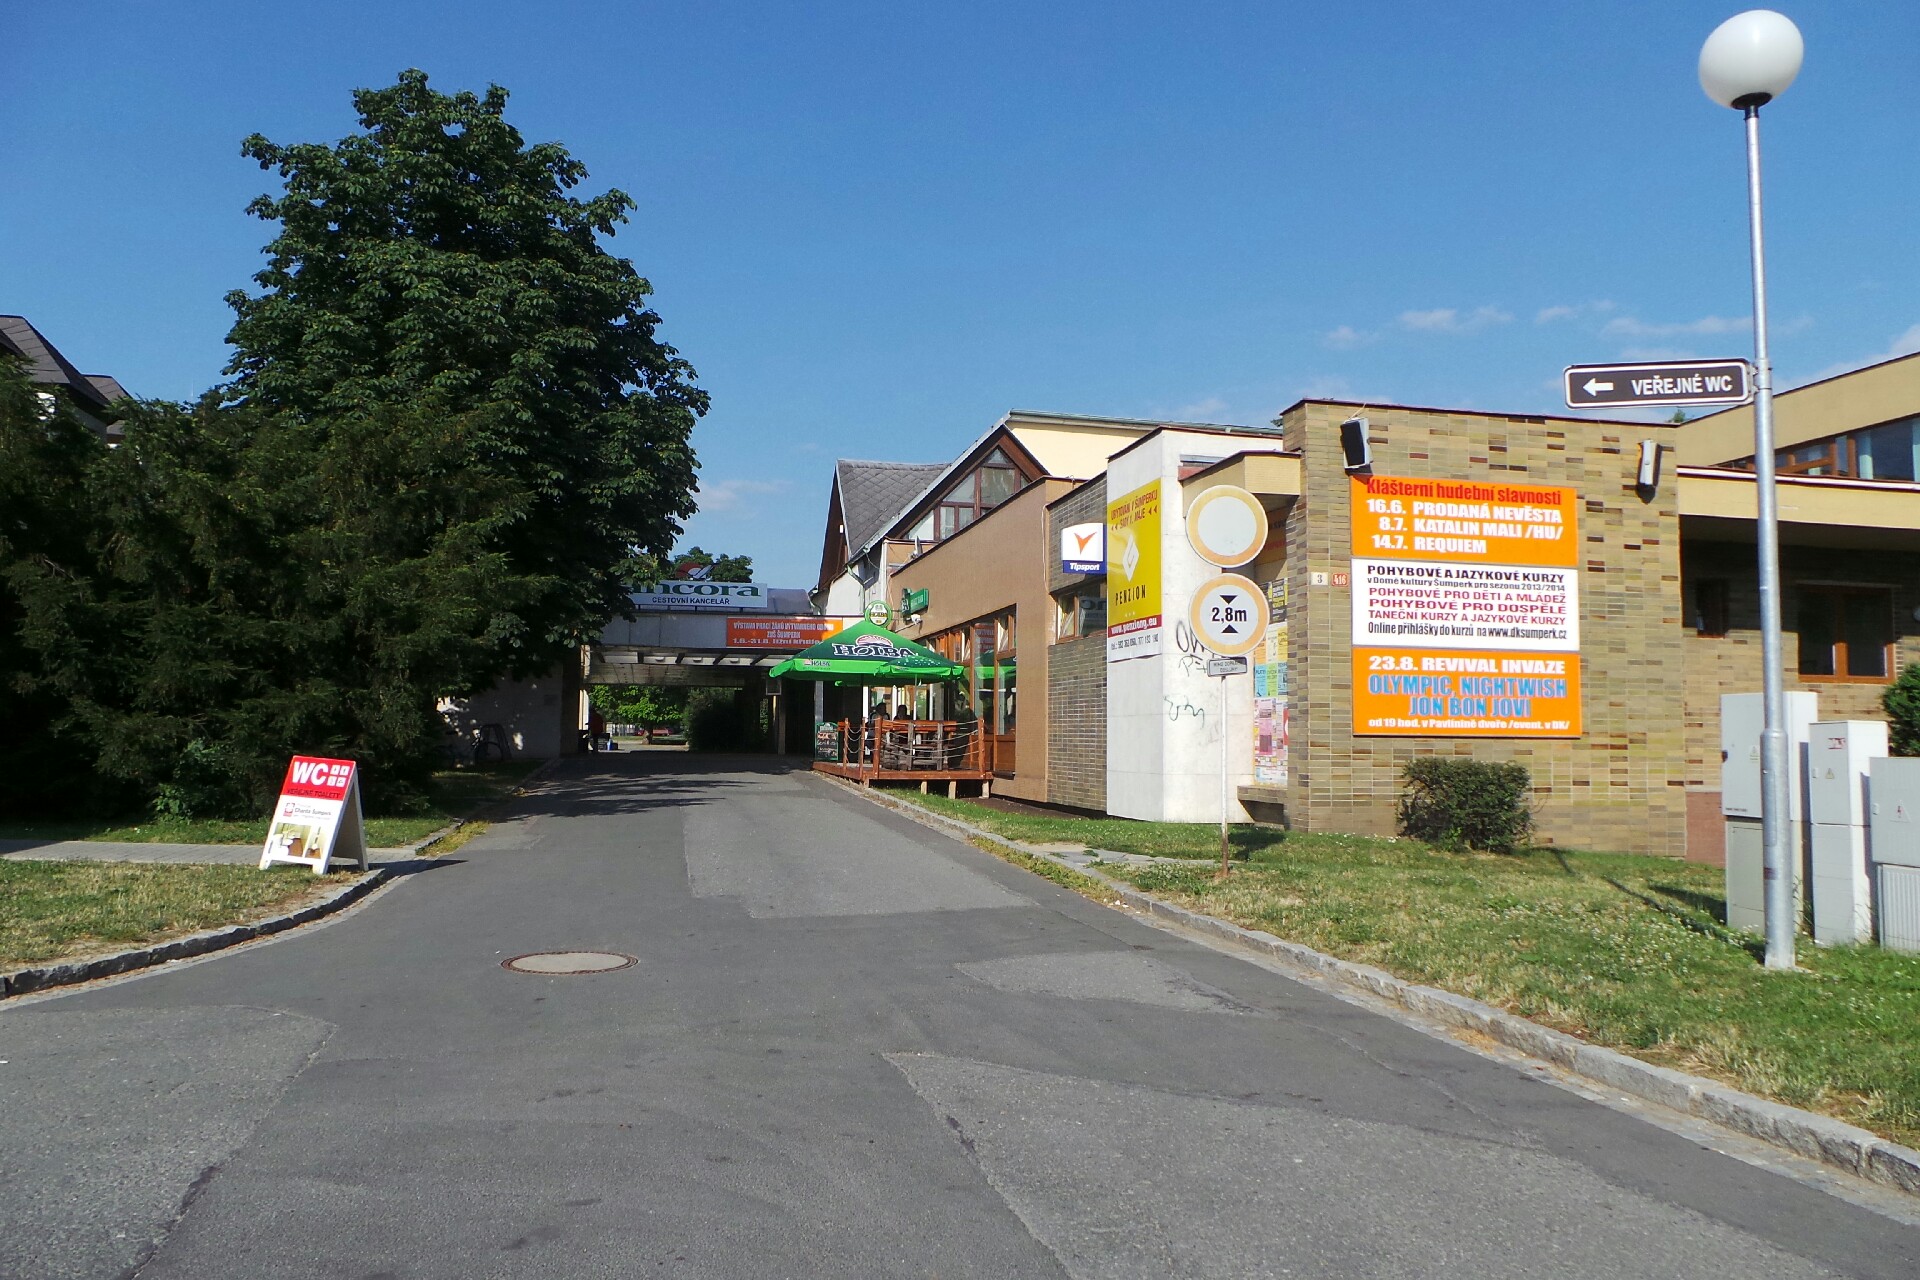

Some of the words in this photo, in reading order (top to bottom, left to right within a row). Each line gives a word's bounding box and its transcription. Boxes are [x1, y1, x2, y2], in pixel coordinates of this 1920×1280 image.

[1631, 374, 1703, 396] VEŘEJNÉ
[1705, 375, 1733, 392] WC
[1367, 479, 1433, 497] Klášterní
[1437, 483, 1495, 501] hudební
[1498, 487, 1562, 505] slavnosti
[1366, 499, 1406, 514] 16.6.
[1413, 501, 1491, 519] PRODANÁ
[1493, 505, 1563, 523] NEVĚSTA
[1379, 516, 1408, 531] 8.7.
[1414, 518, 1480, 535] KATALIN
[1482, 522, 1523, 538] MALI
[1525, 525, 1563, 540] /HU/
[1371, 534, 1408, 550] 14.7.
[1414, 536, 1487, 554] REQUIEM
[1069, 562, 1100, 572] Tipsport
[1367, 565, 1442, 578] POHYBOVÉ
[1444, 569, 1453, 578] A
[1455, 570, 1520, 581] JAZYKOVÉ
[1522, 573, 1564, 583] KURZY
[1317, 575, 1323, 584] 3
[1400, 578, 1432, 587] kultury
[1433, 578, 1473, 588] Šumperk
[1521, 583, 1565, 591] 2013/2014
[690, 597, 730, 605] KANCELÁŘ
[1115, 585, 1146, 606] PENZION
[1369, 588, 1440, 598] POHYBOVÉ
[1444, 591, 1470, 600] PRO
[1473, 590, 1501, 600] DĚTI
[1504, 593, 1513, 601] A
[1516, 592, 1566, 604] MLÁDEŽ
[1211, 607, 1247, 623] 2,8m
[1369, 599, 1458, 610] POHYBOVÉ
[1462, 602, 1494, 612] PRO
[1498, 603, 1567, 614] DOSPĚLÉ
[1368, 609, 1418, 620] TANEČNÍ
[1421, 612, 1458, 621] KURZY
[1461, 613, 1469, 622] A
[1471, 613, 1528, 624] JAZYKOVÉ
[1531, 616, 1565, 625] KURZY
[1368, 621, 1396, 634] Online
[1398, 622, 1438, 636] přihlášky
[1439, 624, 1450, 636] do
[1451, 624, 1474, 636] kurzů
[1477, 627, 1487, 636] na
[1488, 627, 1567, 640] www.dksumperk.cz
[1369, 655, 1418, 671] 23.8.
[1422, 657, 1498, 673] REVIVAL
[1502, 659, 1565, 674] INVAZE
[1369, 674, 1456, 697] OLYMPIC,
[1460, 677, 1567, 698] NIGHTWISH
[1409, 697, 1443, 716] JON
[1449, 697, 1487, 717] BON
[1491, 698, 1531, 718] JOVI
[1369, 718, 1382, 727] od
[1384, 718, 1396, 726] 19
[1397, 718, 1420, 727] hod.
[291, 761, 329, 785] WC
